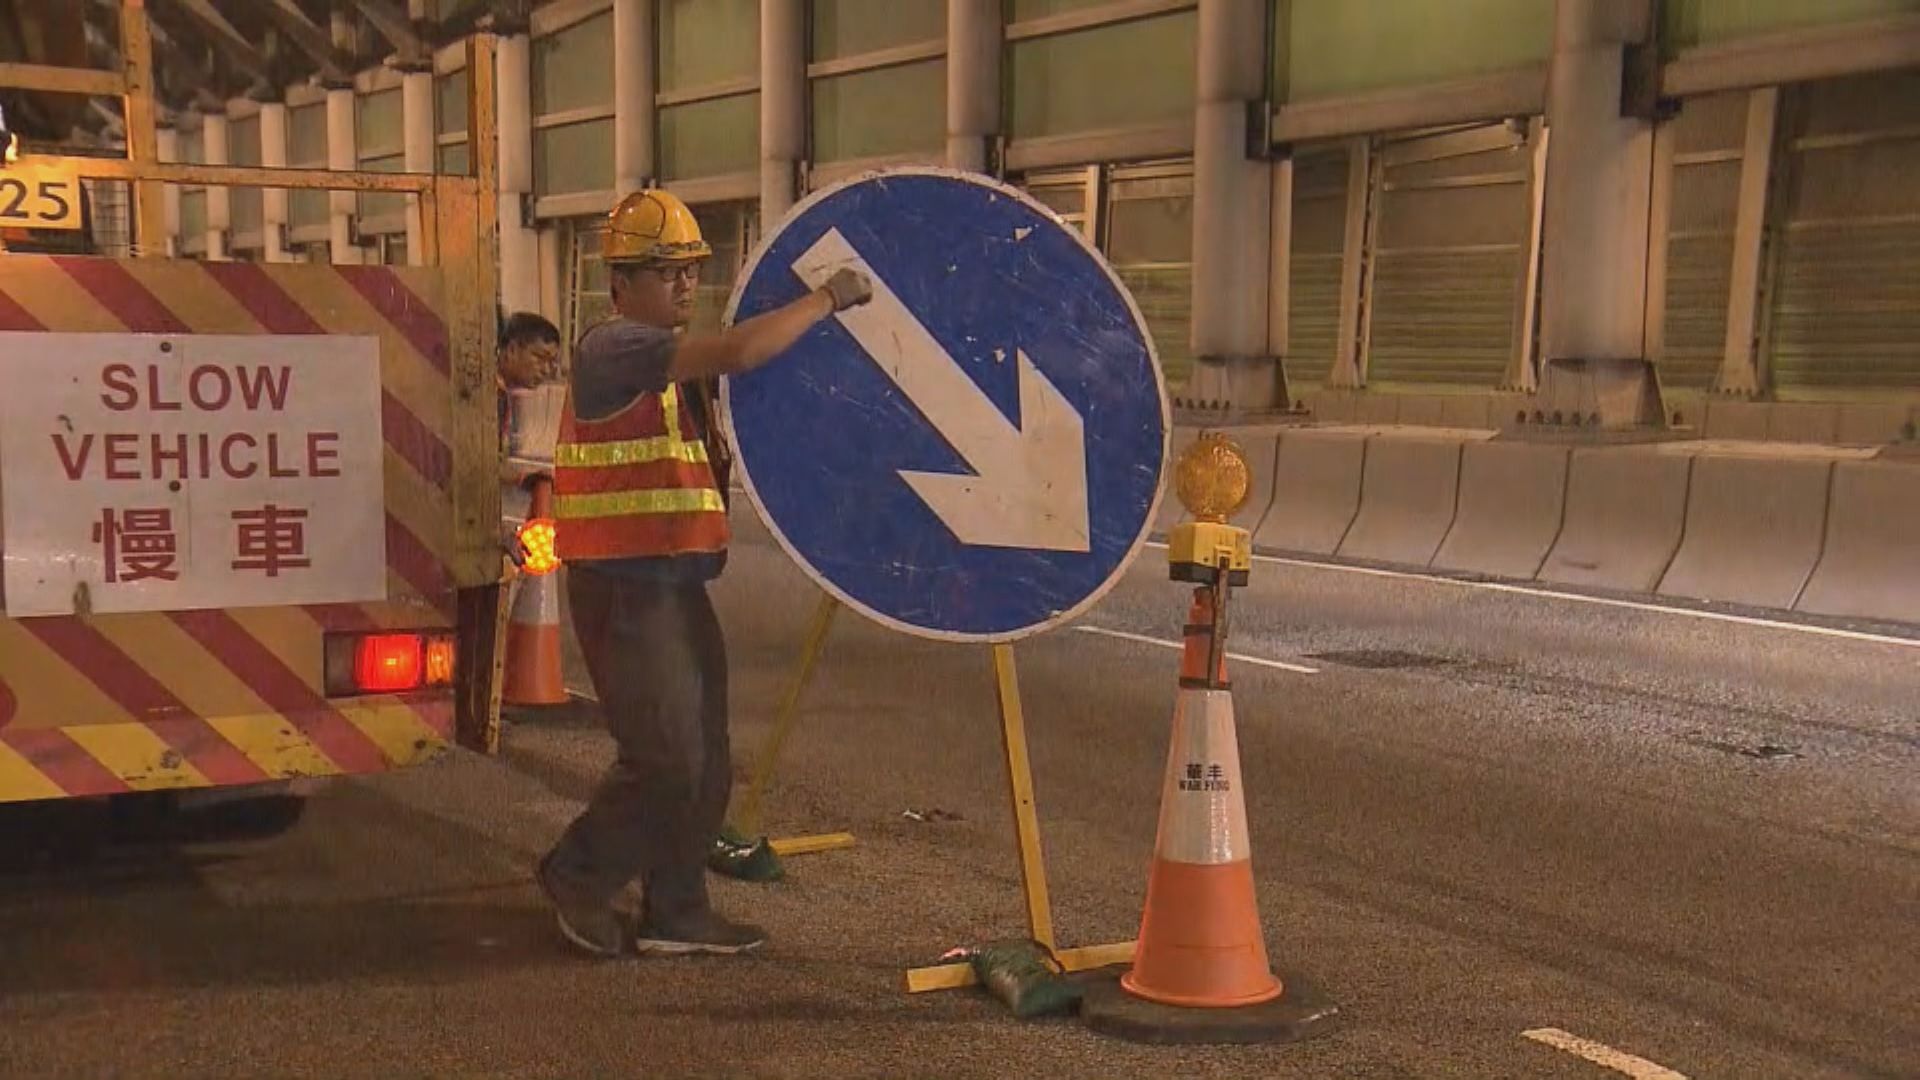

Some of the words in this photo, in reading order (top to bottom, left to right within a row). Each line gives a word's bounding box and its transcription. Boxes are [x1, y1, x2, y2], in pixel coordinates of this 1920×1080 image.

[0, 178, 69, 220] 25
[101, 363, 292, 411] SLOW
[51, 432, 341, 480] VEHICLE
[92, 504, 311, 584] 慢車
